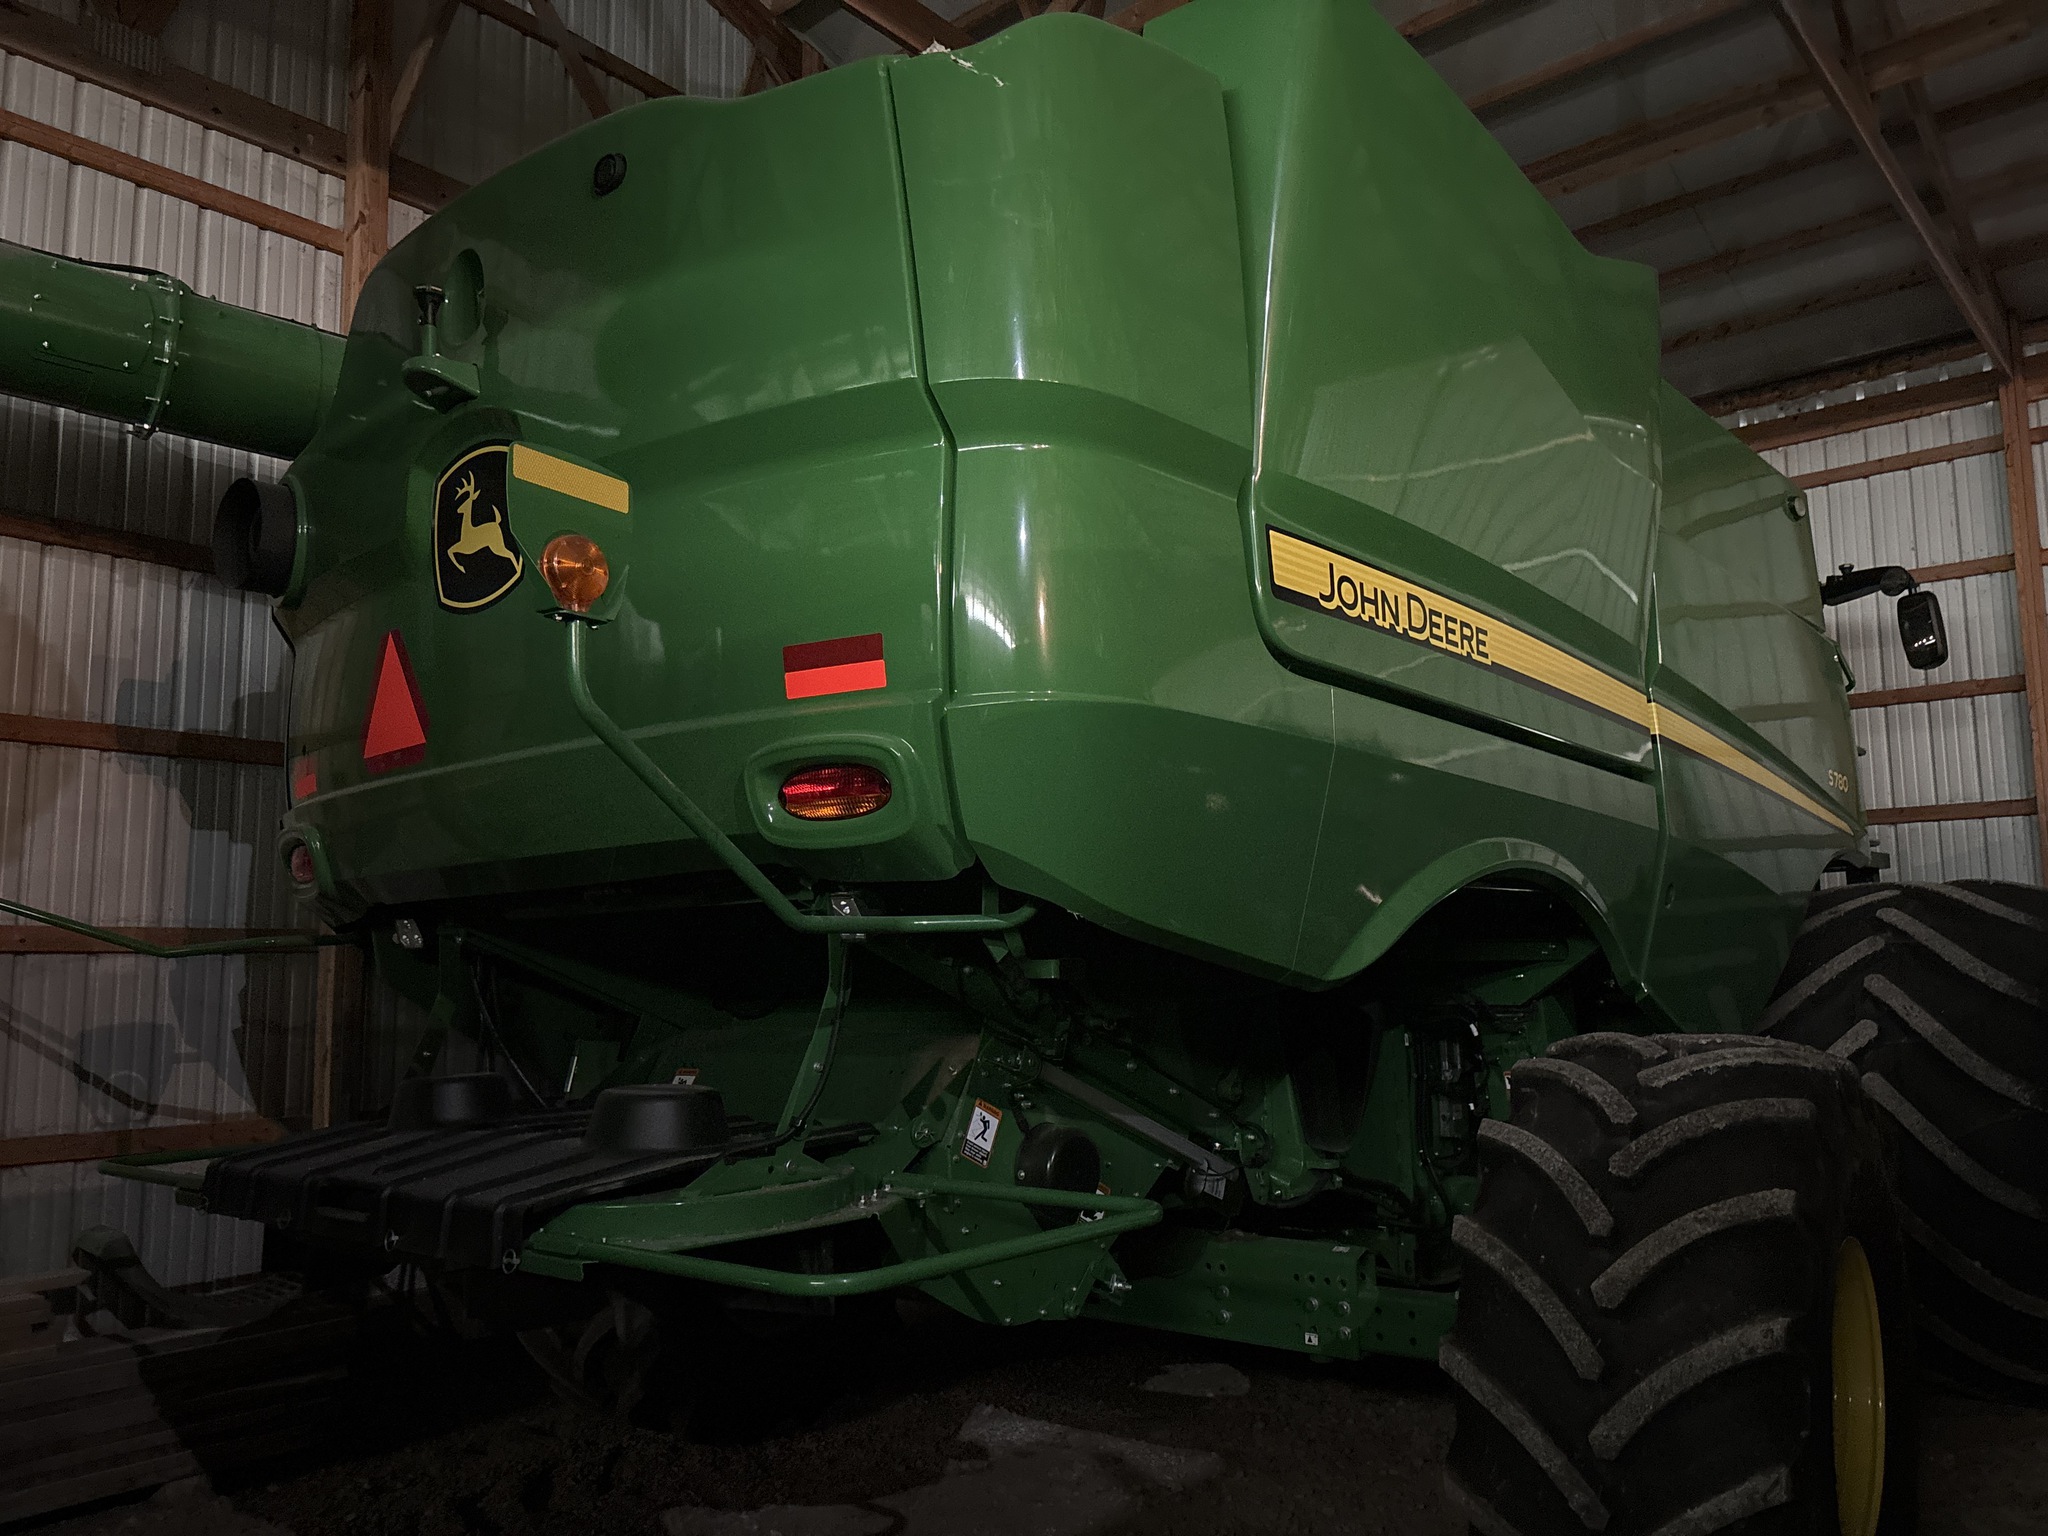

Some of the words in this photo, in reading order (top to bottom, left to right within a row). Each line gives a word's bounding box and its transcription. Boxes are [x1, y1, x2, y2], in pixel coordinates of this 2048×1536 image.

[1318, 562, 1401, 628] JOHN
[1406, 591, 1490, 661] DEERE
[1828, 769, 1849, 793] S780
